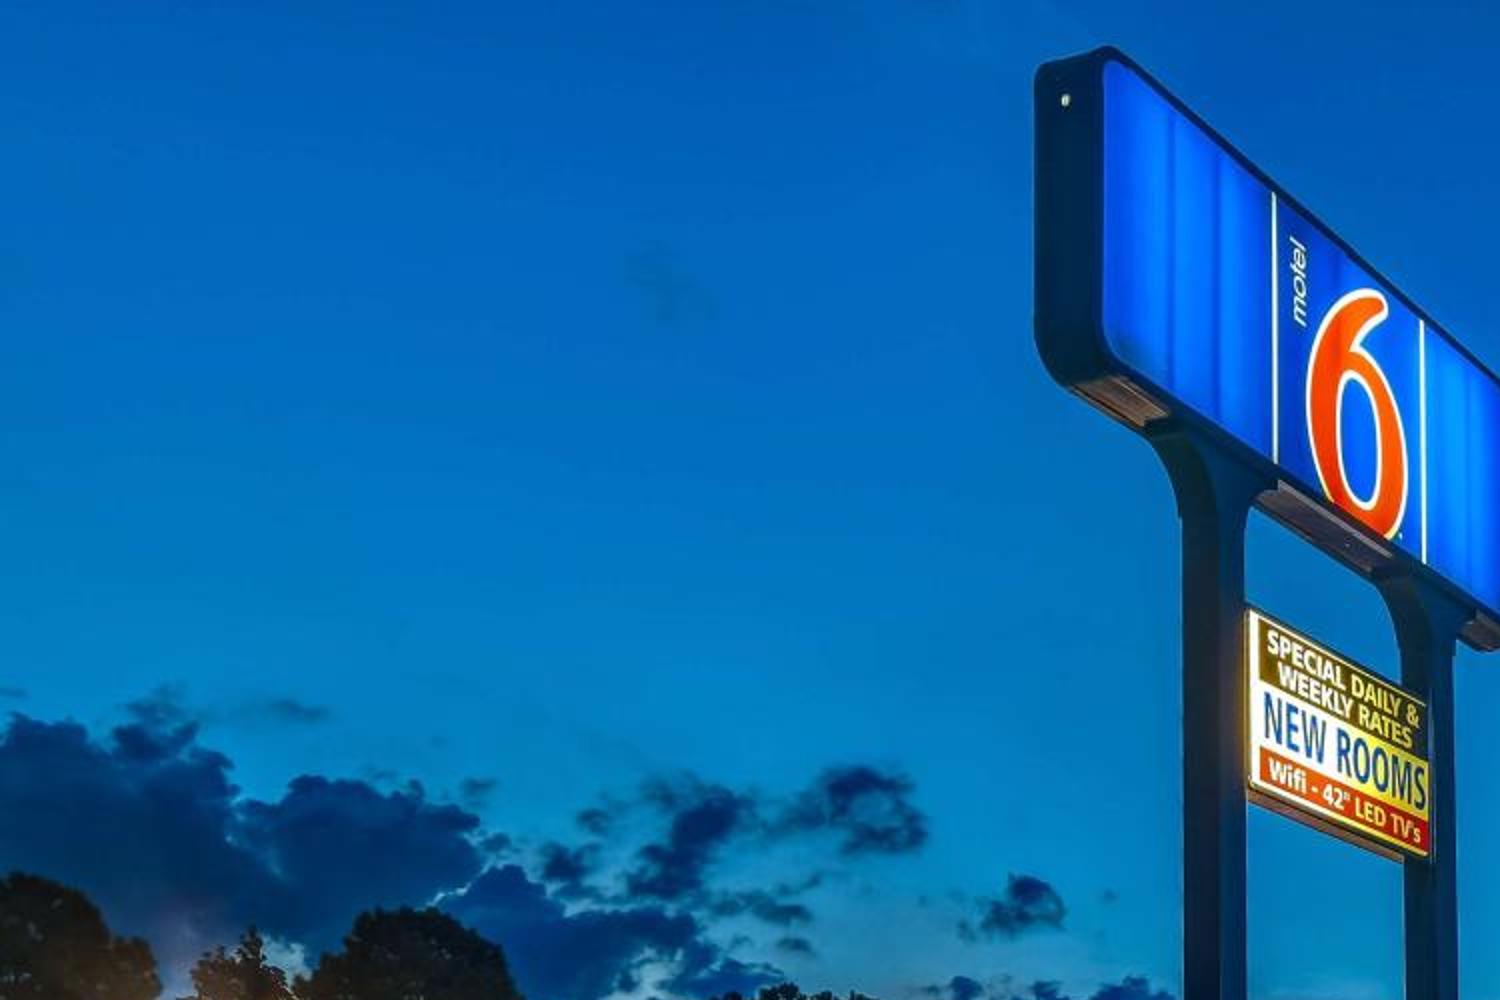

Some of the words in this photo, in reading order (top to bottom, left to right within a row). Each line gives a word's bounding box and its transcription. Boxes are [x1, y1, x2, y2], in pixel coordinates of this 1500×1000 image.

[1290, 236, 1307, 328] motel
[1306, 288, 1409, 541] 6
[1267, 629, 1346, 691] SPECIAL
[1351, 674, 1401, 718] DAILY
[1406, 703, 1420, 729] &
[1277, 662, 1353, 719] WEEKLY
[1359, 707, 1414, 750] RATES
[1263, 691, 1327, 766] NEW
[1337, 727, 1427, 811] ROOMS
[1269, 757, 1308, 794] Wifi
[1355, 798, 1387, 827] LED
